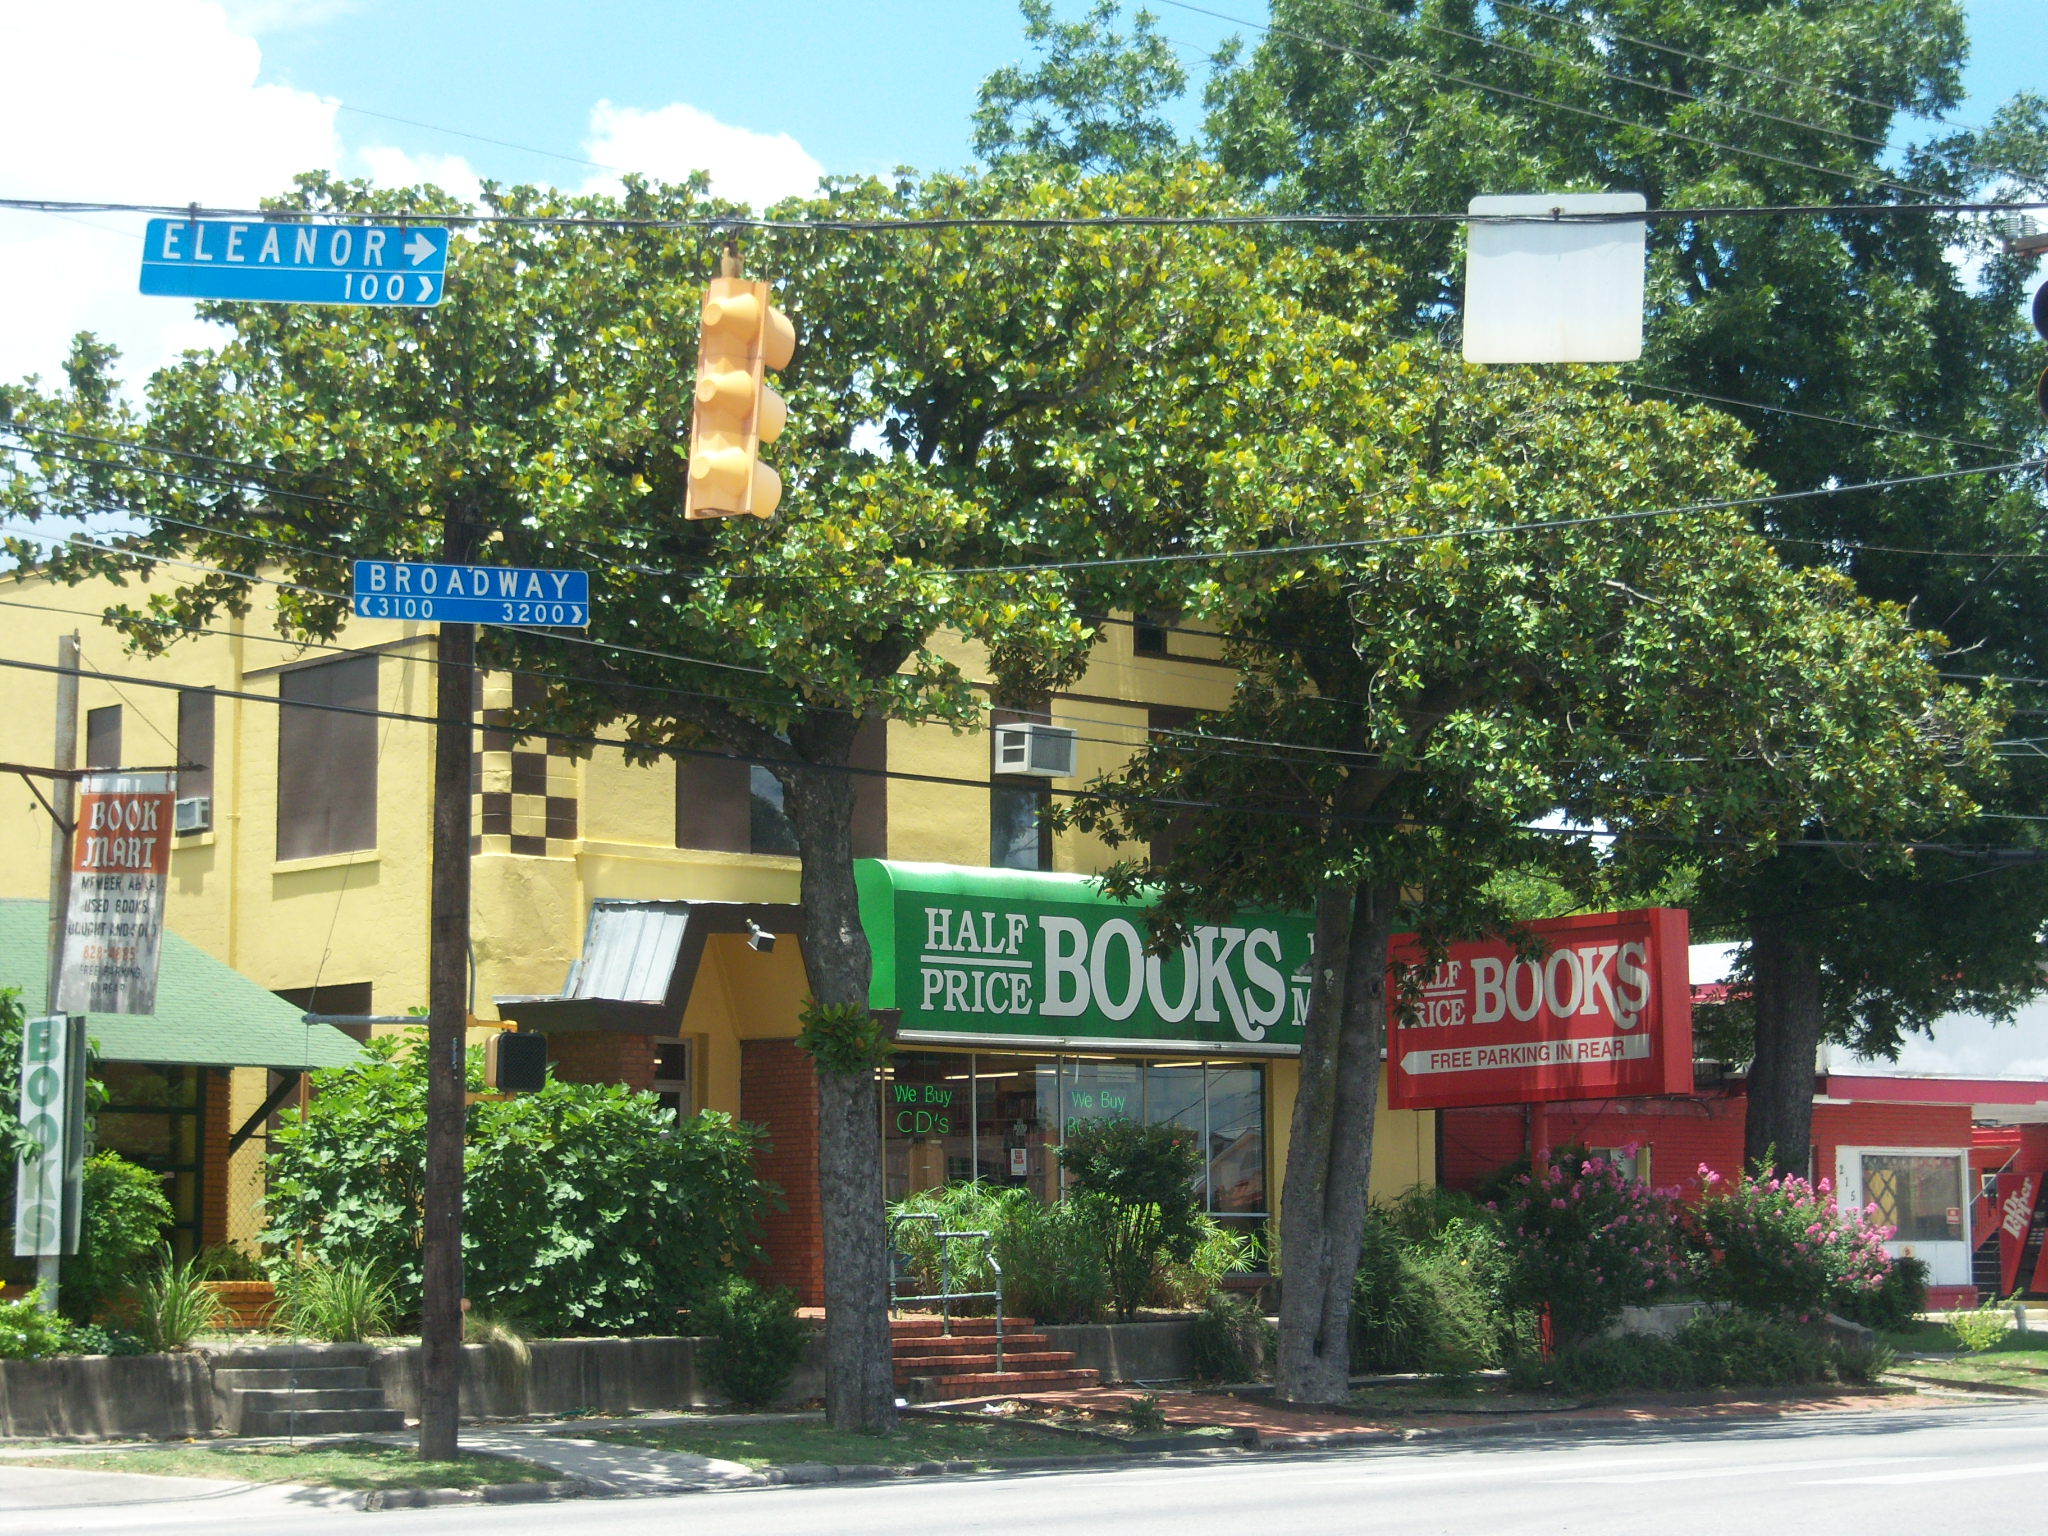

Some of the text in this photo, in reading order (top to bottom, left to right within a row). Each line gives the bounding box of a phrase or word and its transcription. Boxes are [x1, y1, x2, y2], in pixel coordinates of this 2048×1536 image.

[162, 222, 386, 267] ELEANOR
[343, 272, 405, 301] 100
[370, 564, 569, 599] BROADWAY
[378, 598, 434, 619] 3100
[502, 603, 564, 623] 3200
[89, 799, 160, 832] BOOK
[81, 836, 157, 868] MART
[84, 898, 149, 914] USED BOOKS
[924, 907, 1029, 955] HALF
[920, 968, 1033, 1015] PRICE
[1039, 915, 1285, 1042] BOOKS
[1470, 941, 1650, 1030] BOOKS
[1430, 1039, 1625, 1070] FREE PARKING IN REAR
[894, 1084, 953, 1108] We Buy
[1071, 1090, 1125, 1113] We Buy
[21, 1019, 62, 1250] BOOKS
[896, 1110, 950, 1134] CD's
[2002, 1176, 2033, 1240] Pepper
